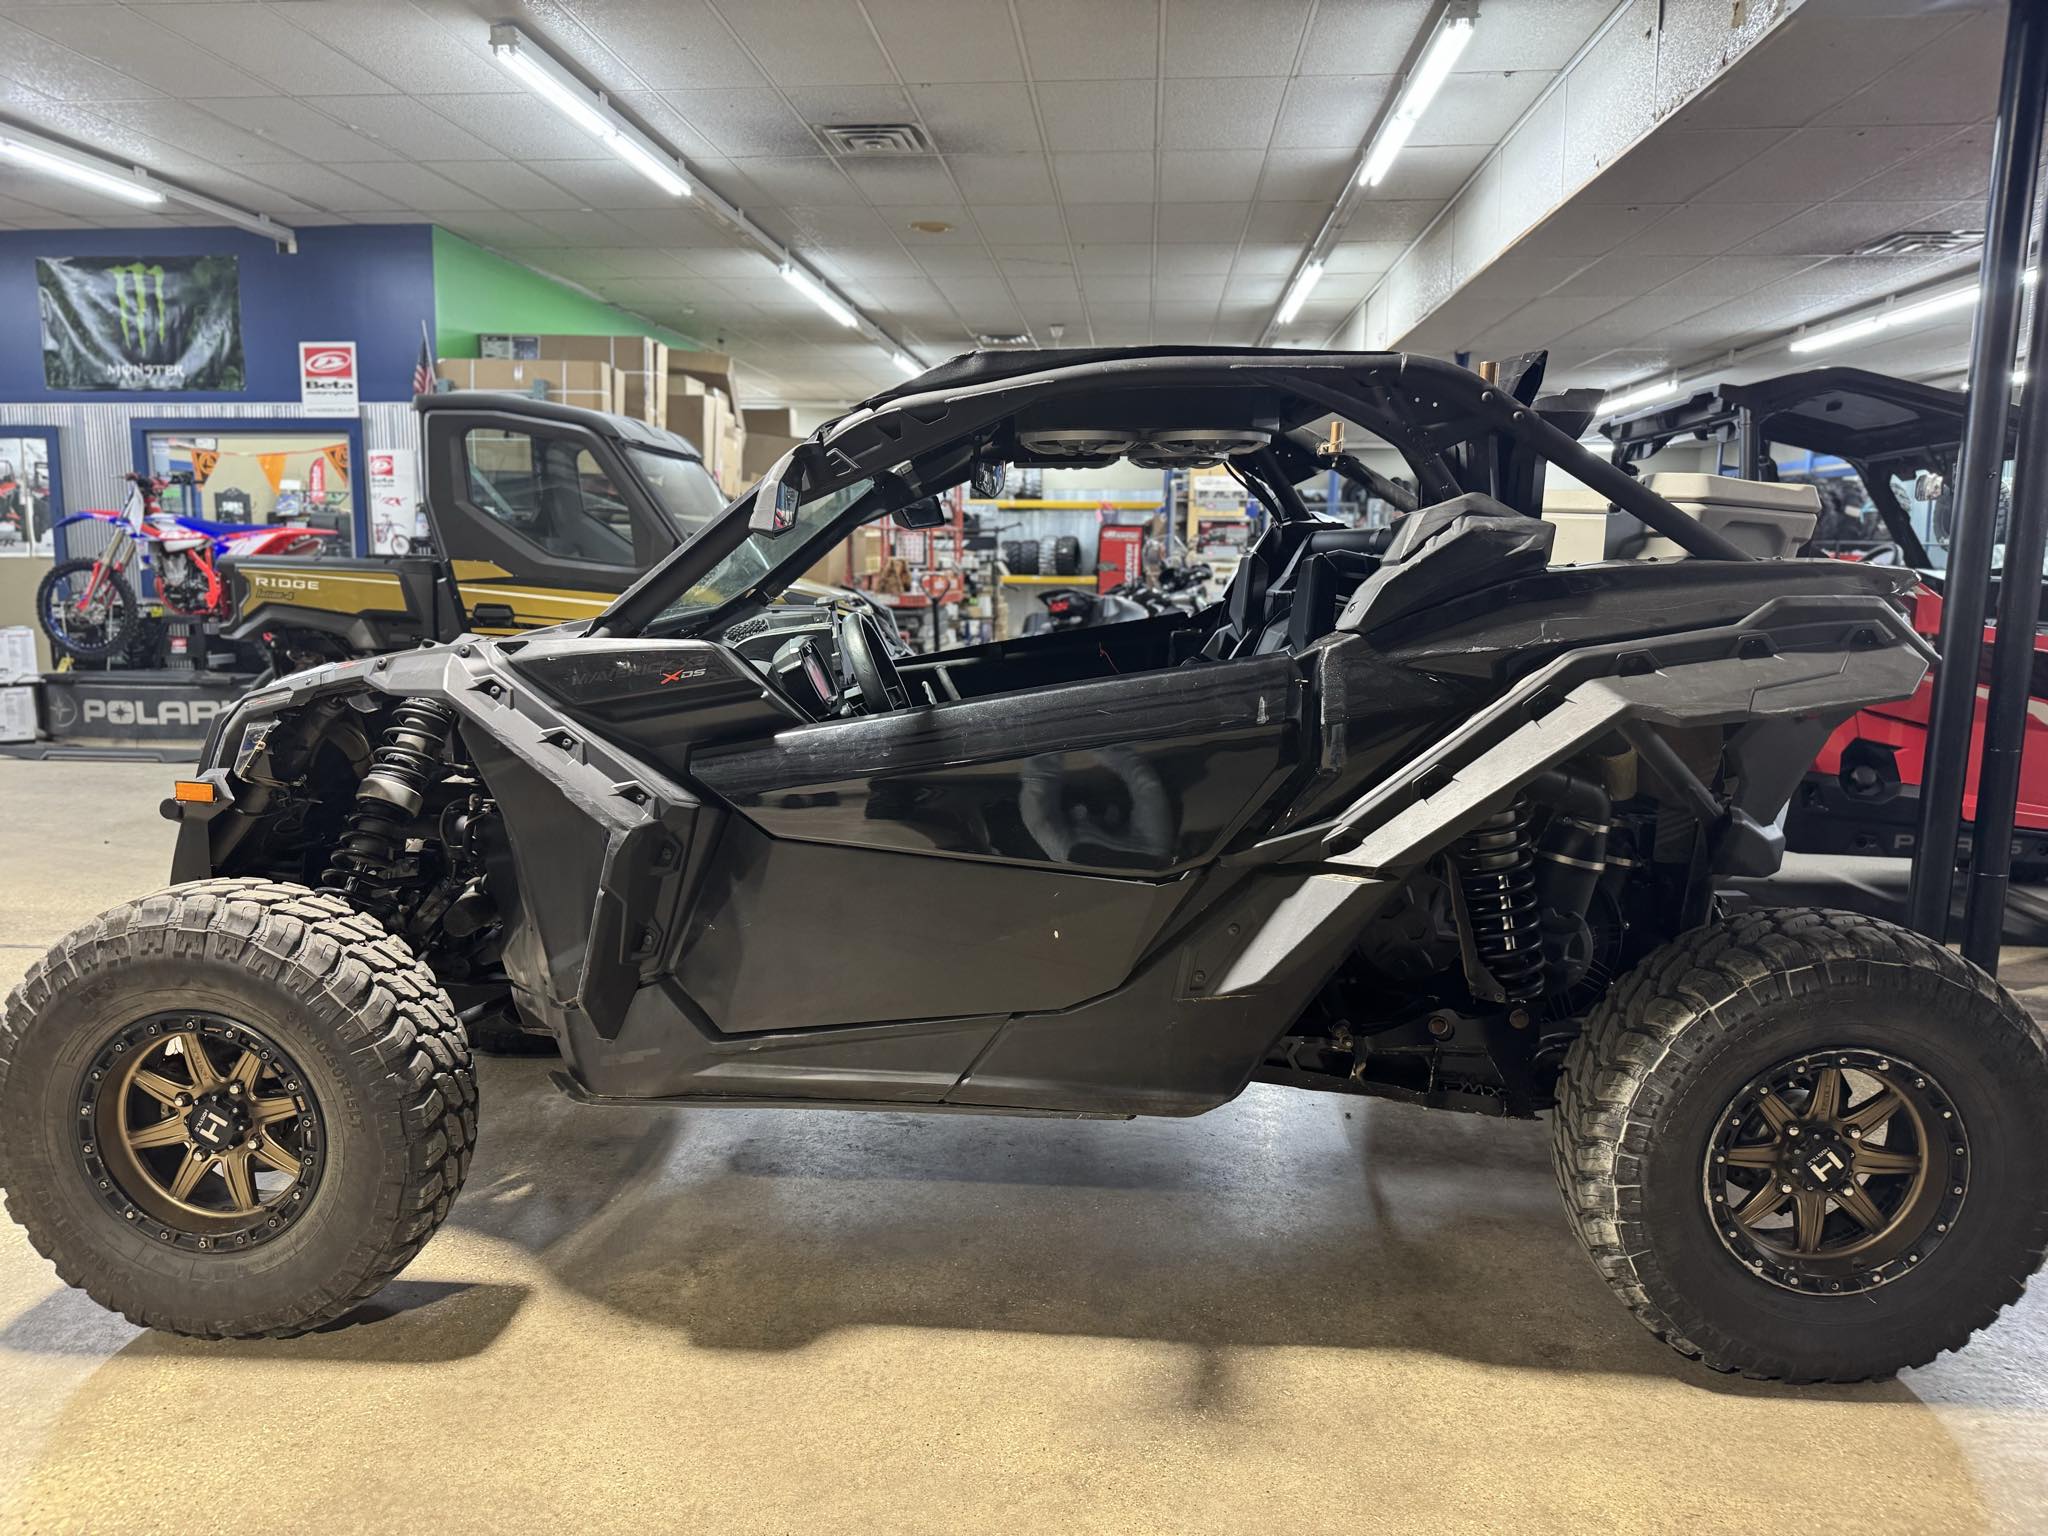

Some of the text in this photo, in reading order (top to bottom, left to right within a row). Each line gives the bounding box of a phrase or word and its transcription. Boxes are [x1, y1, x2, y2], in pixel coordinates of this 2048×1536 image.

[106, 363, 185, 379] MONSTER
[306, 381, 353, 389] Beta
[255, 577, 320, 590] RIDGE
[82, 700, 232, 725] POLAR
